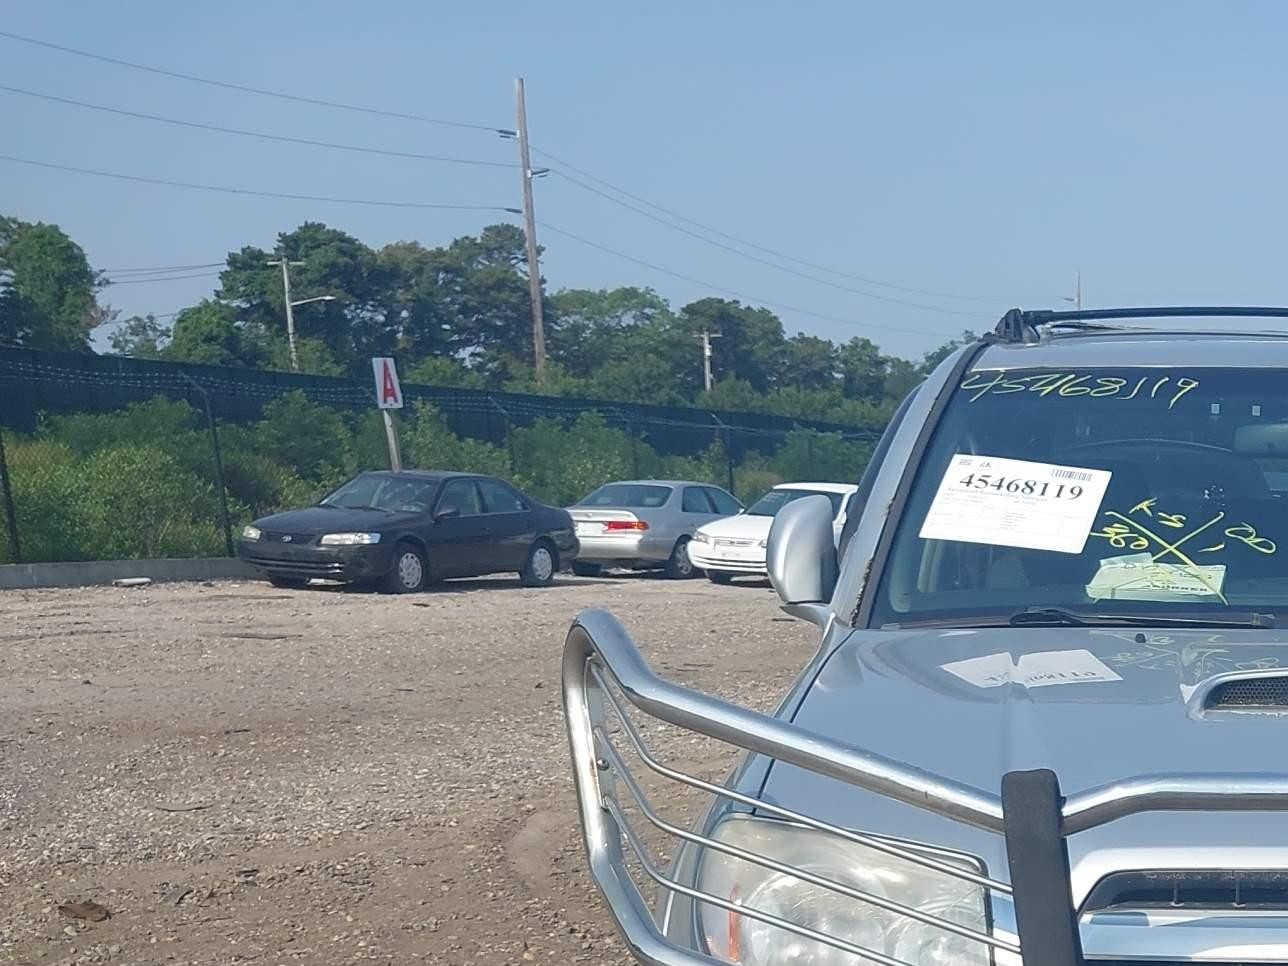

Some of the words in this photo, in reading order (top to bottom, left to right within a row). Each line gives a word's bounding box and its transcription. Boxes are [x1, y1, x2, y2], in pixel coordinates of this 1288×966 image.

[383, 360, 399, 404] A
[961, 374, 1200, 409] 45468119
[960, 473, 1084, 501] 45468119
